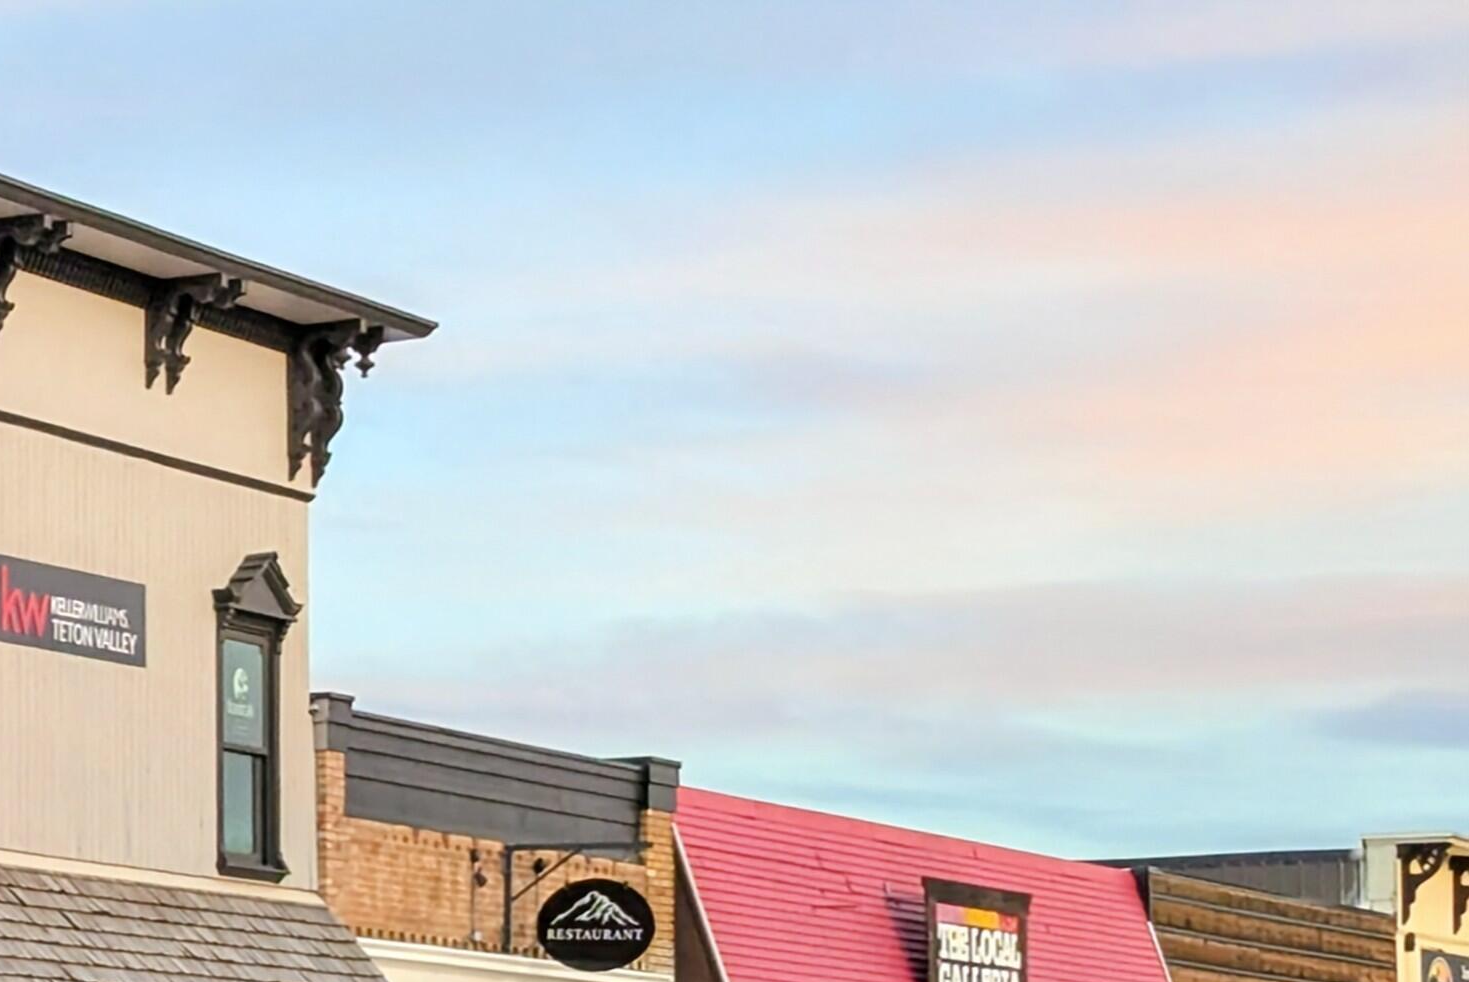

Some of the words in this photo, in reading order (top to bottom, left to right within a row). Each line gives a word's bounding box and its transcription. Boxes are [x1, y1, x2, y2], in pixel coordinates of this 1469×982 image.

[0, 564, 50, 638] kw
[51, 595, 130, 629] KELLERWILLIAMS
[51, 619, 93, 648] TETON
[94, 627, 138, 656] VALLEY
[546, 928, 644, 940] RESTAURANT
[970, 927, 1023, 969] LOCAL
